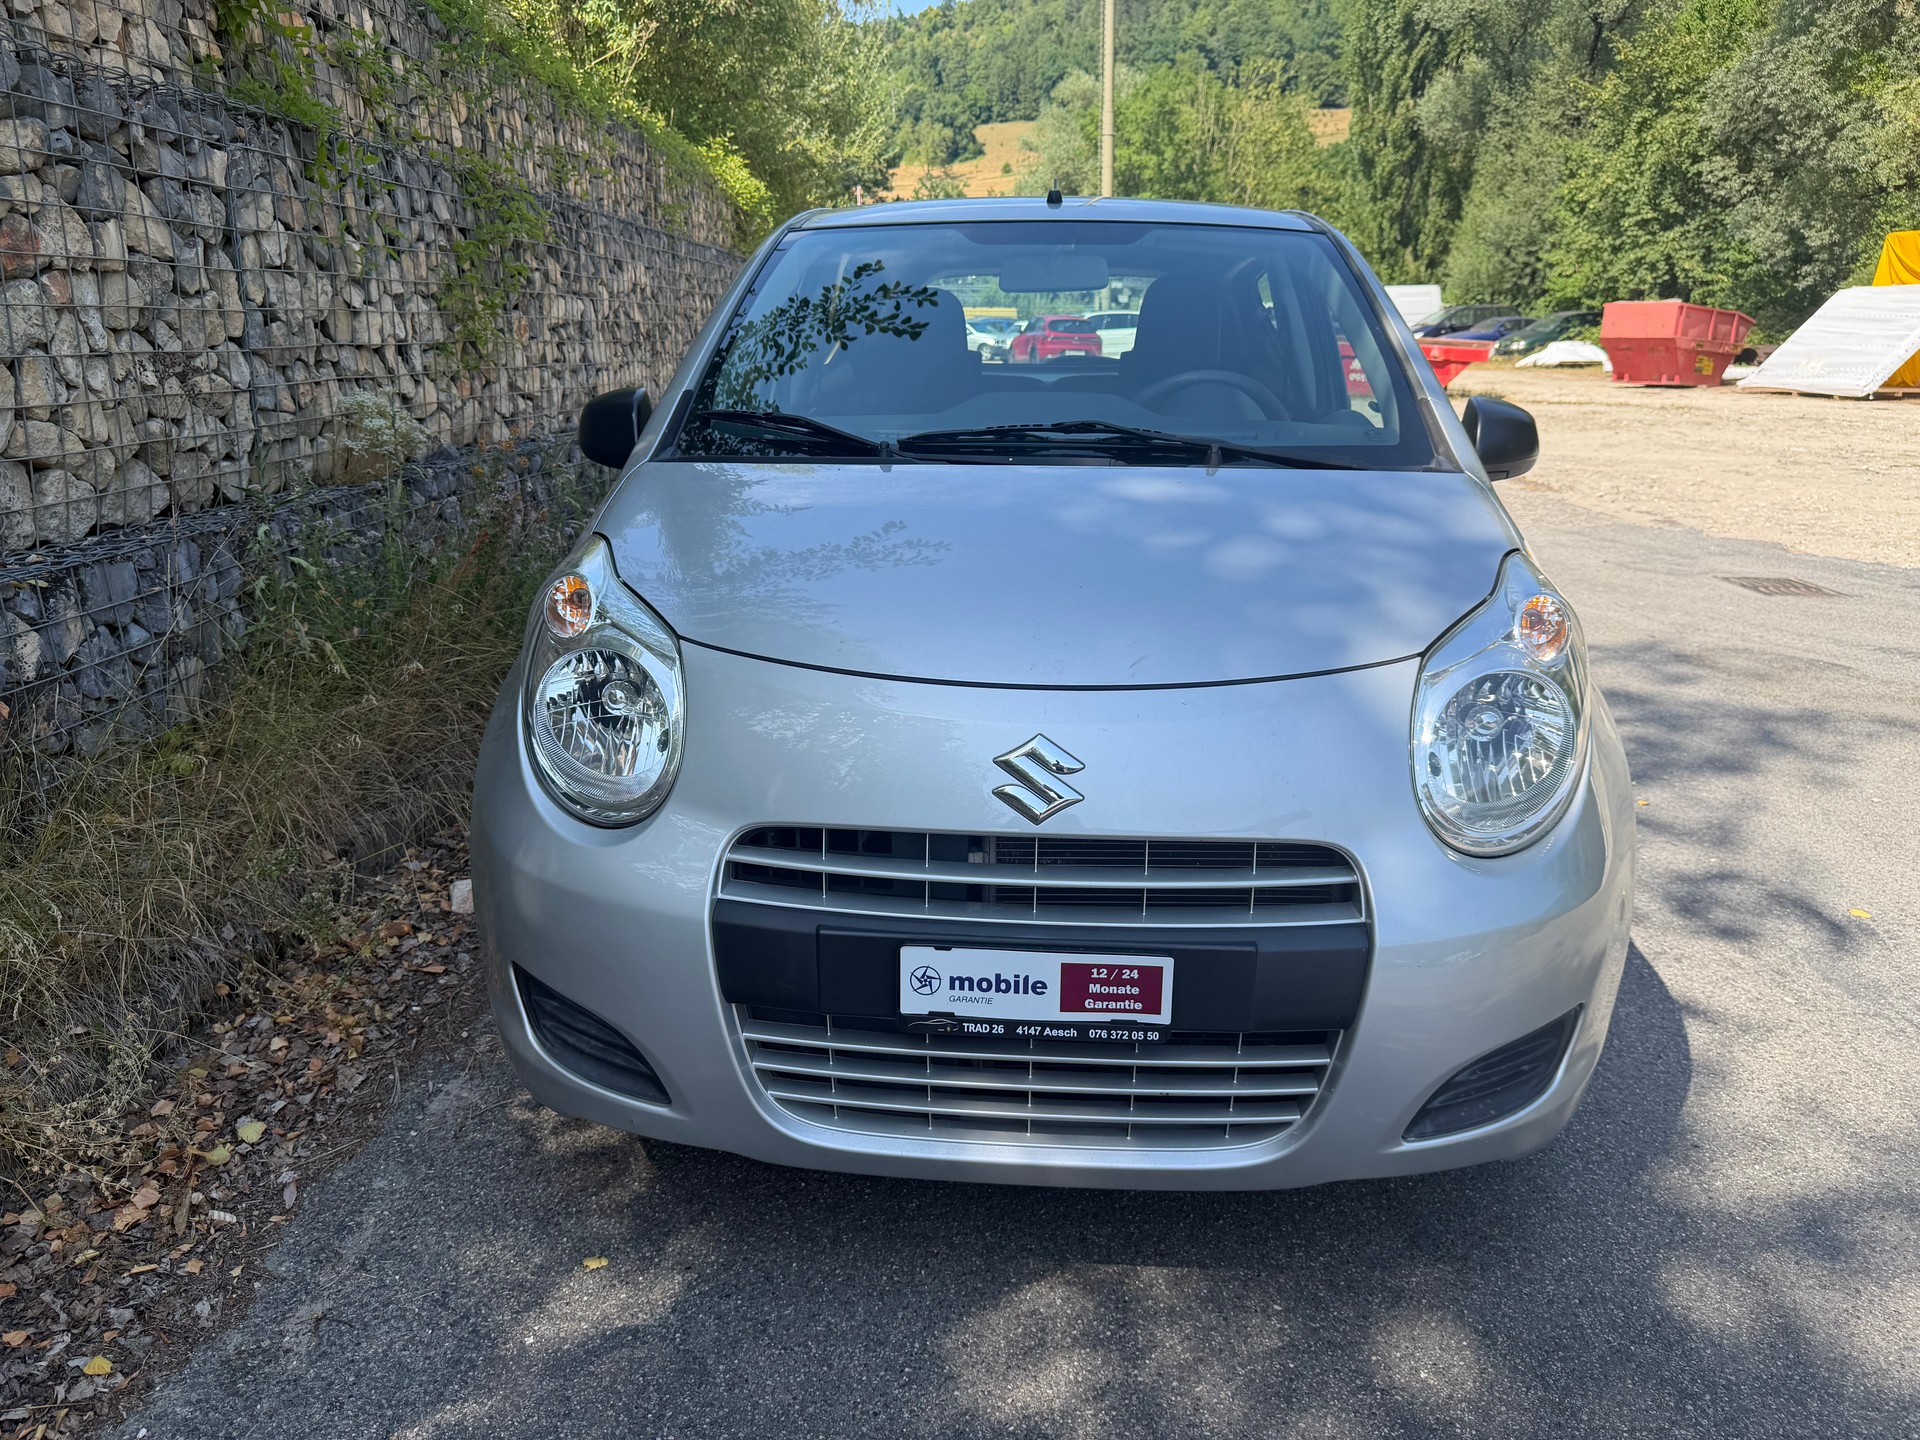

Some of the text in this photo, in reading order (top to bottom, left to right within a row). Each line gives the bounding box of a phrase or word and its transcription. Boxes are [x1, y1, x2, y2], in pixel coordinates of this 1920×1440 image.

[1091, 969, 1139, 979] 12 / 24
[949, 973, 1048, 996] mobile
[1088, 984, 1139, 995] Monate
[949, 996, 993, 1004] GARANTIE
[1085, 999, 1142, 1010] Garantie
[963, 1023, 1004, 1034] TRAD 26
[1016, 1026, 1077, 1037] 4147 Aesch
[1089, 1029, 1159, 1040] 076 372 05 50
